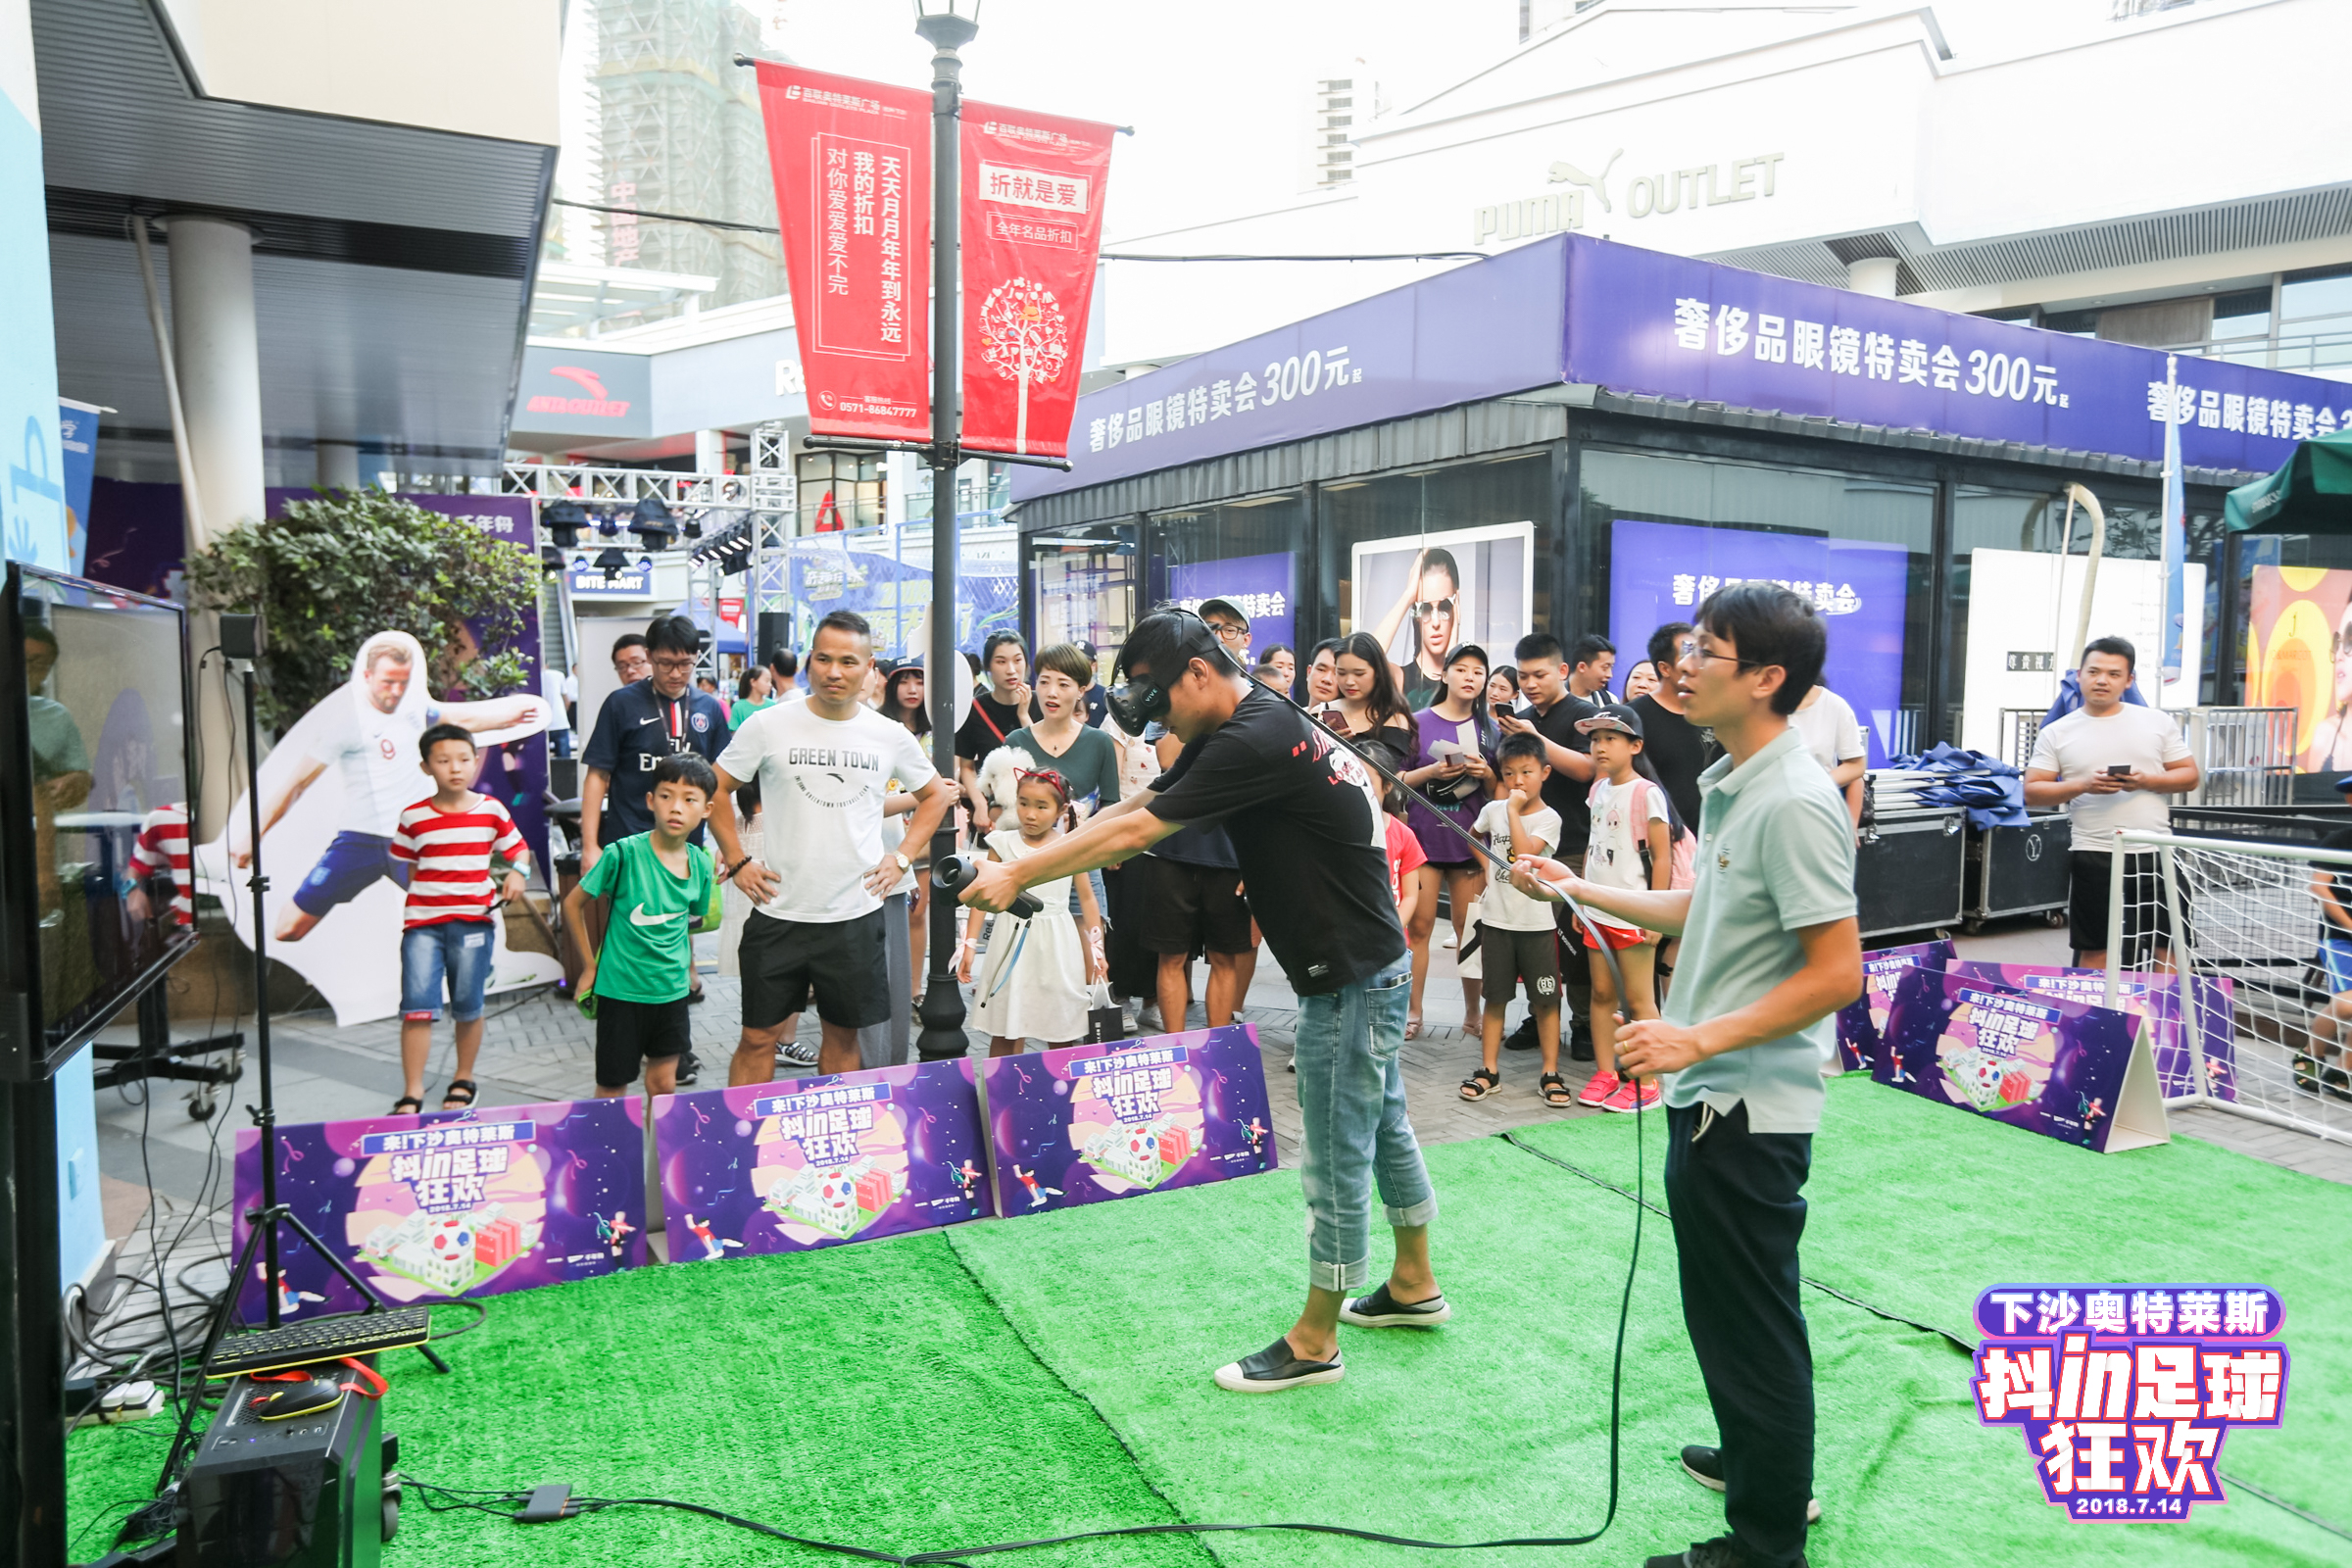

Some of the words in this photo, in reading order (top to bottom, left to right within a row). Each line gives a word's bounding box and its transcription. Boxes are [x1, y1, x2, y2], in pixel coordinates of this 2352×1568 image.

[854, 151, 875, 235] 我的折扣
[990, 172, 1076, 207] 折就是爱
[1474, 189, 1584, 245] PUMA
[1626, 152, 1785, 219] OUTLET
[827, 148, 849, 296] 对你爱爱爱不完
[996, 220, 1072, 244] 全年名品折扣
[880, 155, 902, 343] 天天月月年年到永远
[840, 401, 917, 418] 0571-86847777
[575, 574, 606, 590] BITE
[1672, 573, 1856, 614] 奢侈特卖会
[1179, 590, 1286, 619] 奢侈特卖会
[1145, 688, 1157, 702] VIVE
[380, 738, 396, 760] 9
[789, 747, 836, 766] GREEN
[842, 750, 878, 771] TOWN
[982, 919, 995, 941] Ree
[2038, 977, 2132, 995] 来!下沙奥特斯
[1969, 1006, 2039, 1041] 抖in足球
[1978, 1027, 2020, 1054] 狂欢
[1092, 1067, 1172, 1099] 抖in足球
[1111, 1091, 1160, 1118] 狂欢
[1123, 1113, 1152, 1123] 2018.7.14
[781, 1105, 872, 1141] 抖in足球
[803, 1132, 858, 1161] 狂欢
[392, 1147, 508, 1182] 抖in足球
[815, 1156, 850, 1167] 2018.7.14
[415, 1174, 485, 1207] 狂欢
